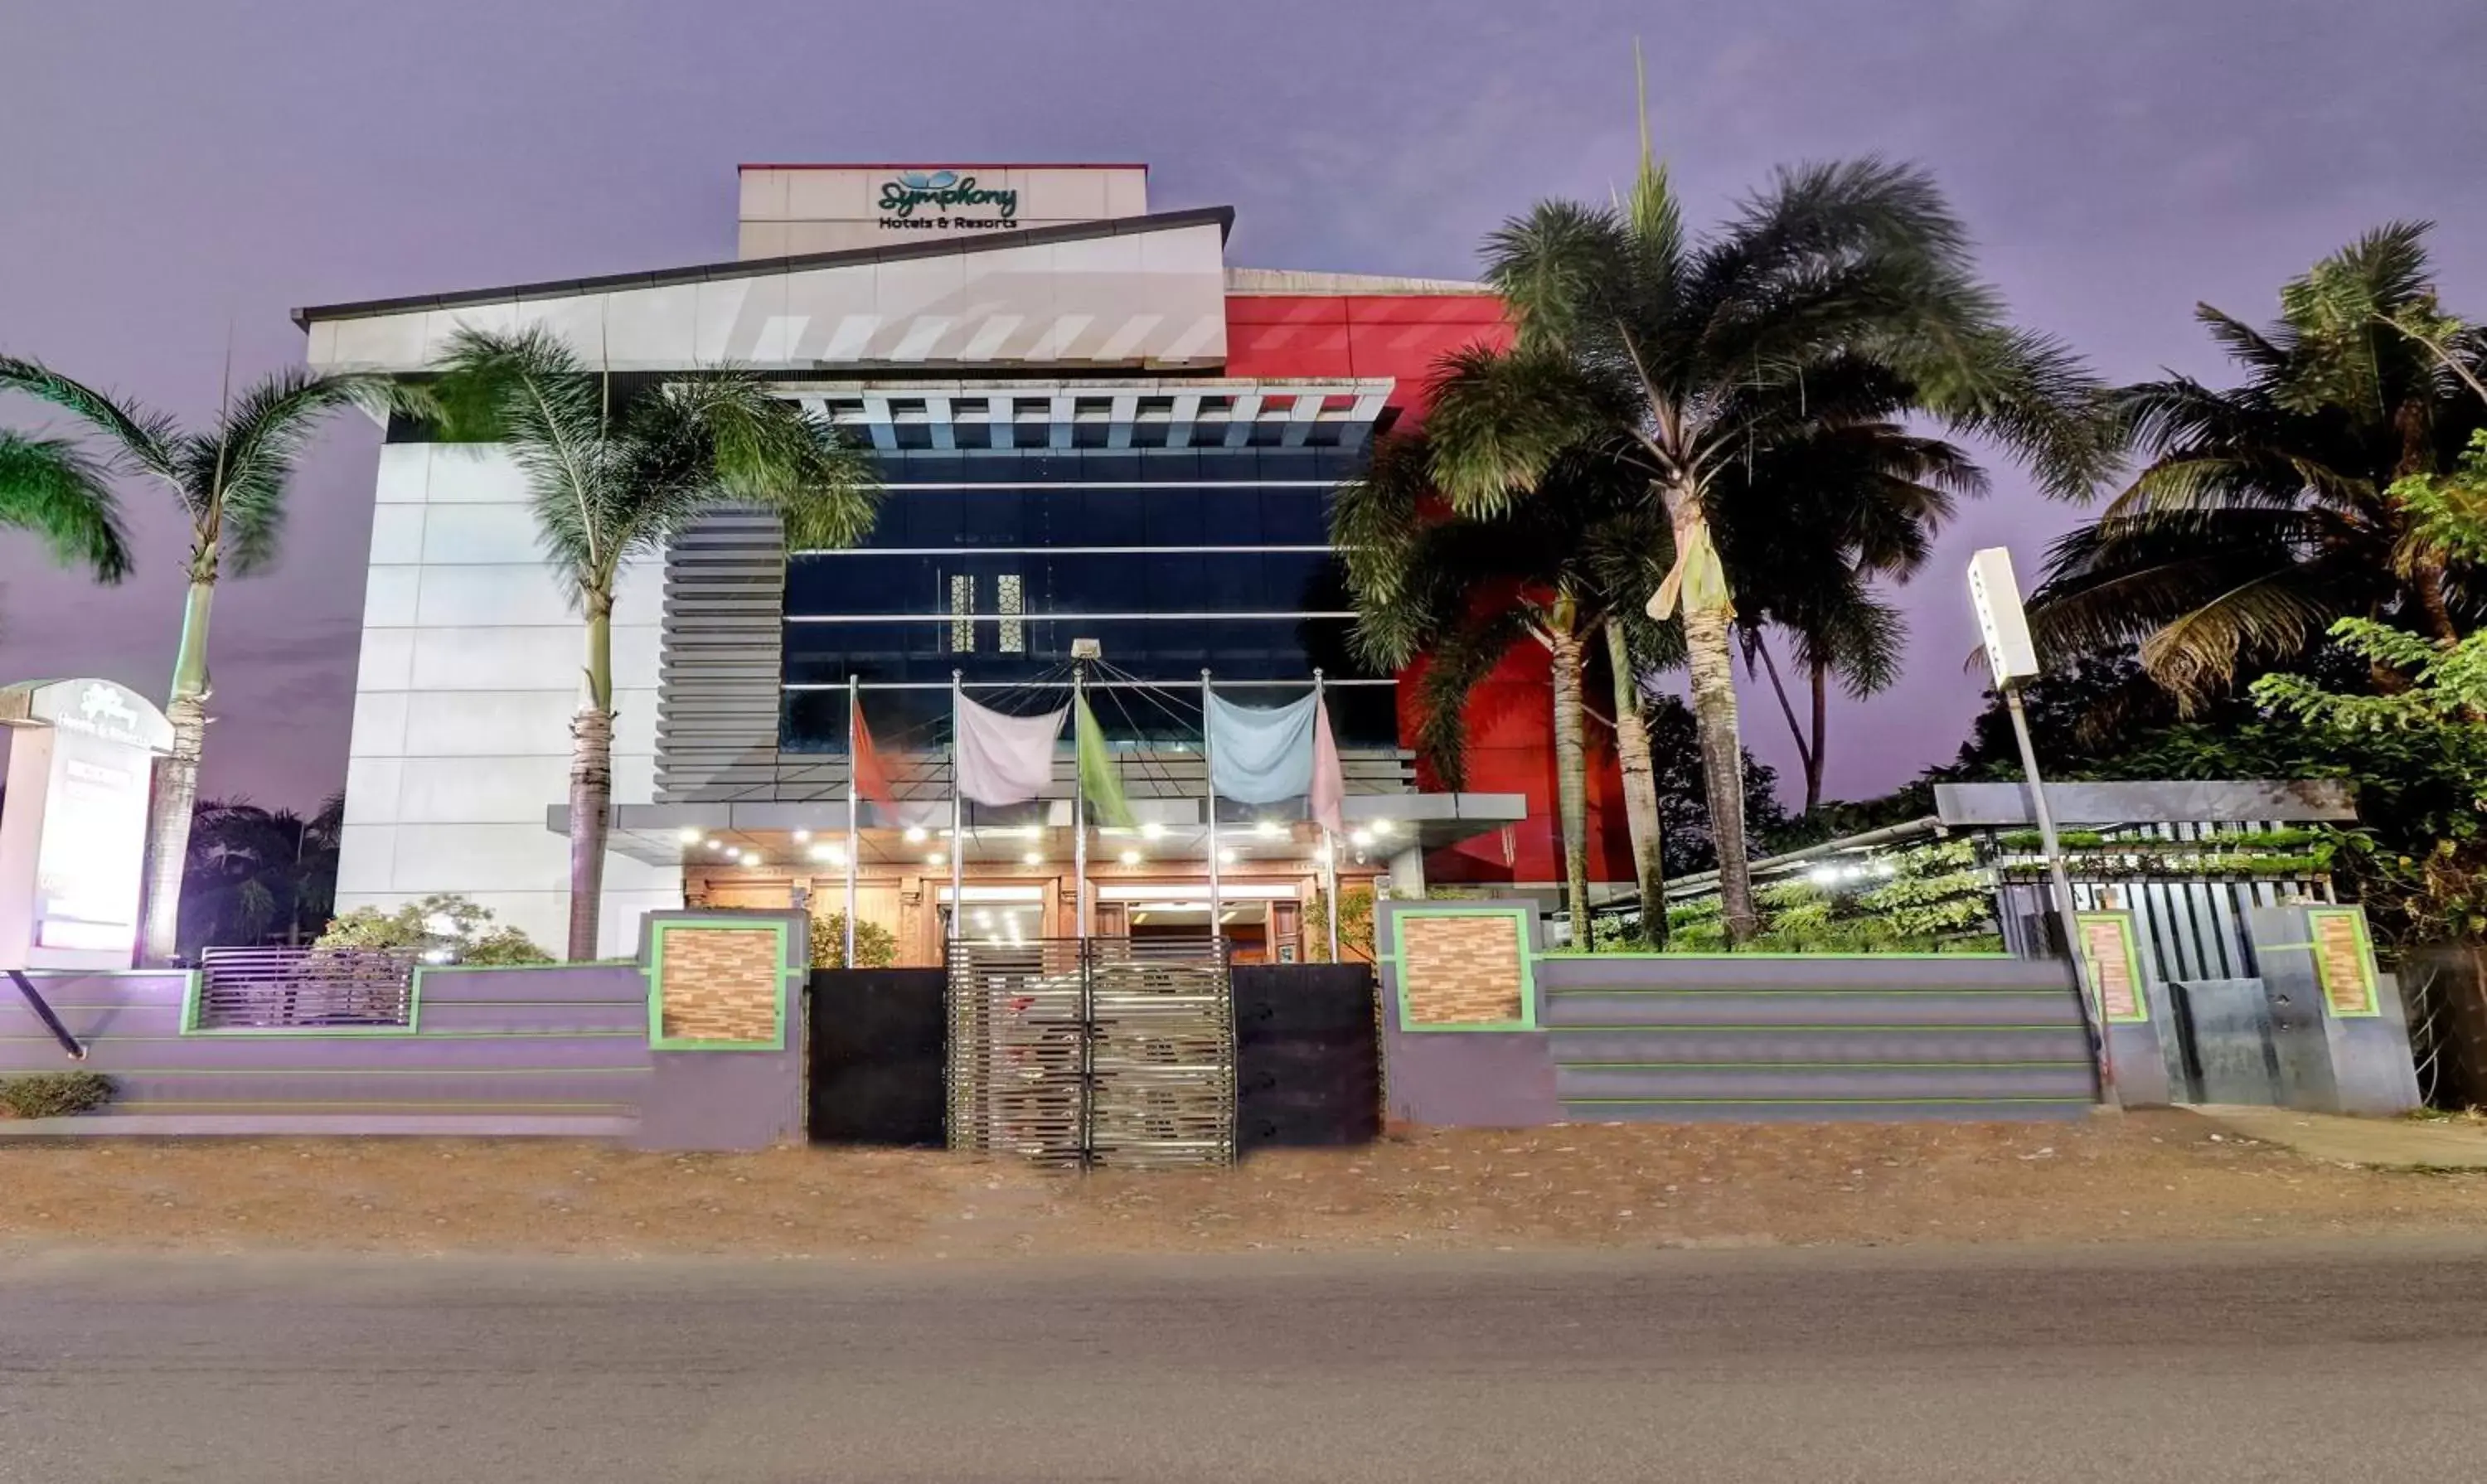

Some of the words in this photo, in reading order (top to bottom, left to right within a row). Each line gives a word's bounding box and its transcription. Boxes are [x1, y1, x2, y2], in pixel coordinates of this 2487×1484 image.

[878, 177, 1017, 218] Symphony
[879, 217, 933, 229] Hotels
[938, 217, 949, 229] &
[954, 217, 1017, 229] Resorts
